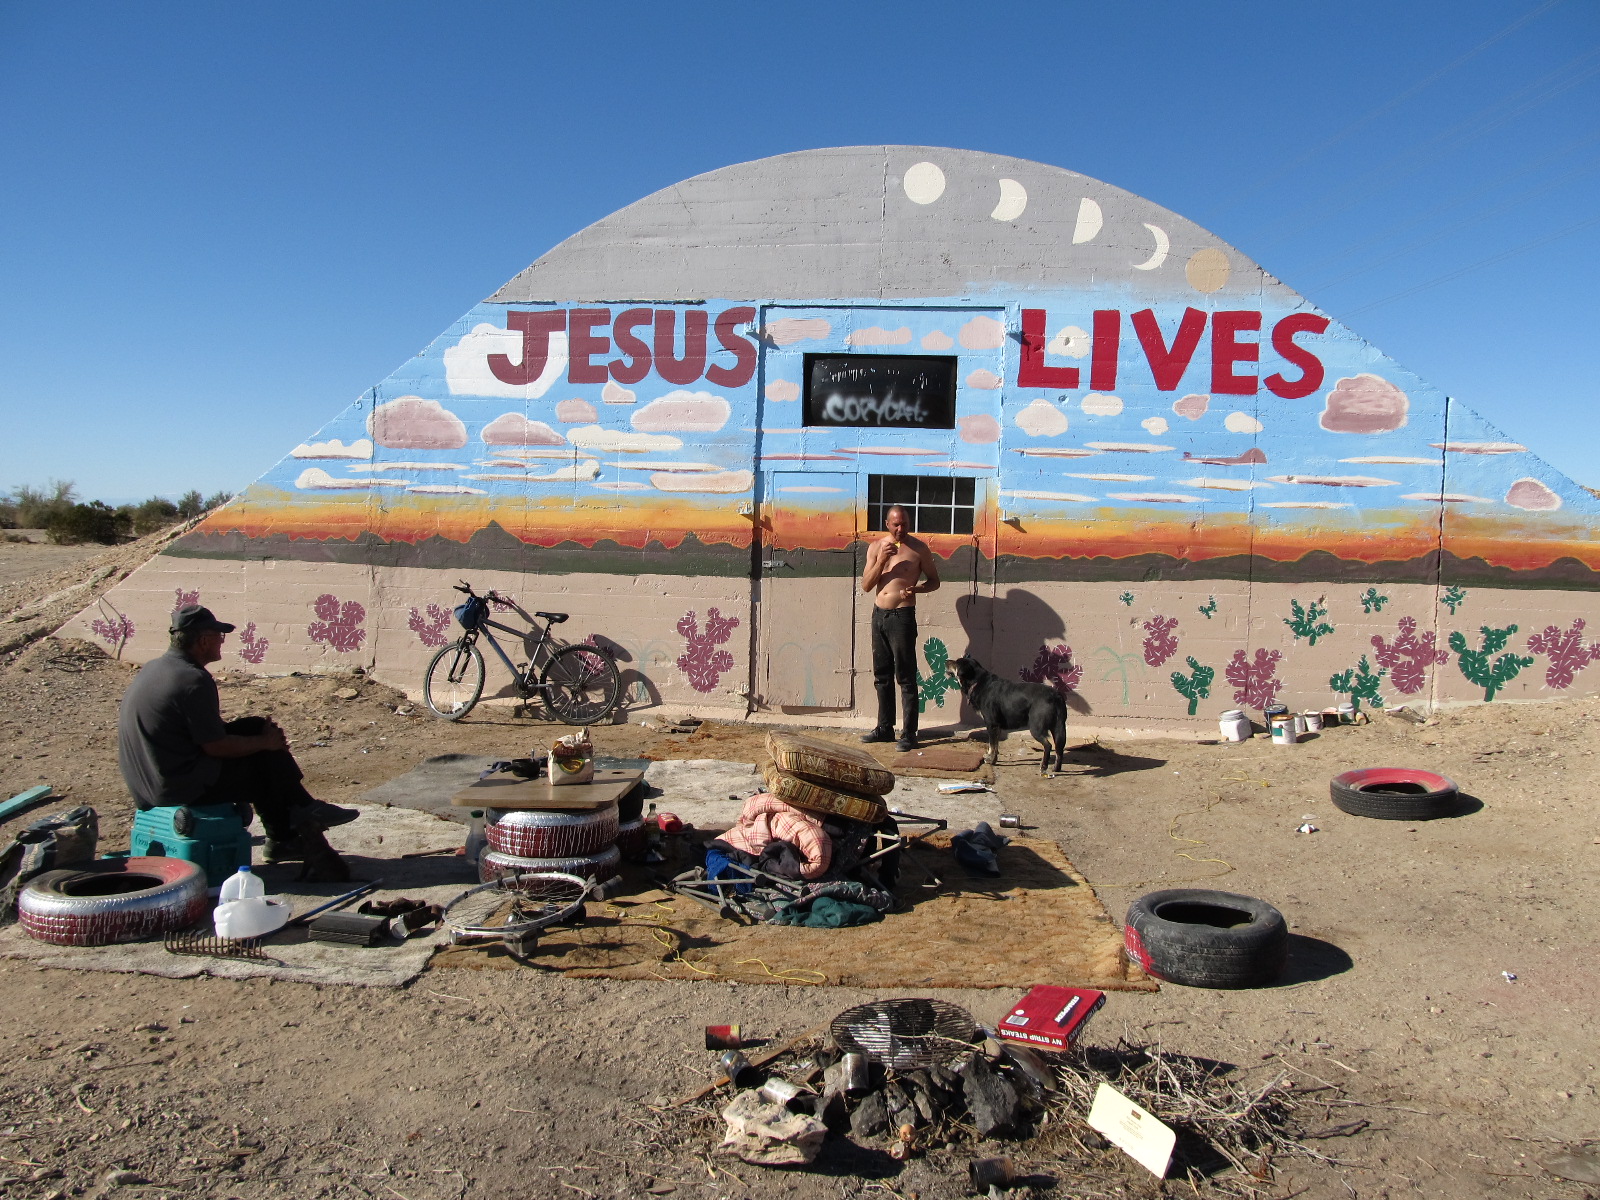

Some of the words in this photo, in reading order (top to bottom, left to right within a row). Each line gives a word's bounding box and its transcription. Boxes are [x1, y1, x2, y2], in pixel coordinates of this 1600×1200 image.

[487, 306, 756, 388] JESUS
[1018, 307, 1330, 399] LIVES
[1000, 1029, 1028, 1040] STEAKS
[1029, 1034, 1050, 1044] STRIP
[1051, 1038, 1063, 1046] NY
